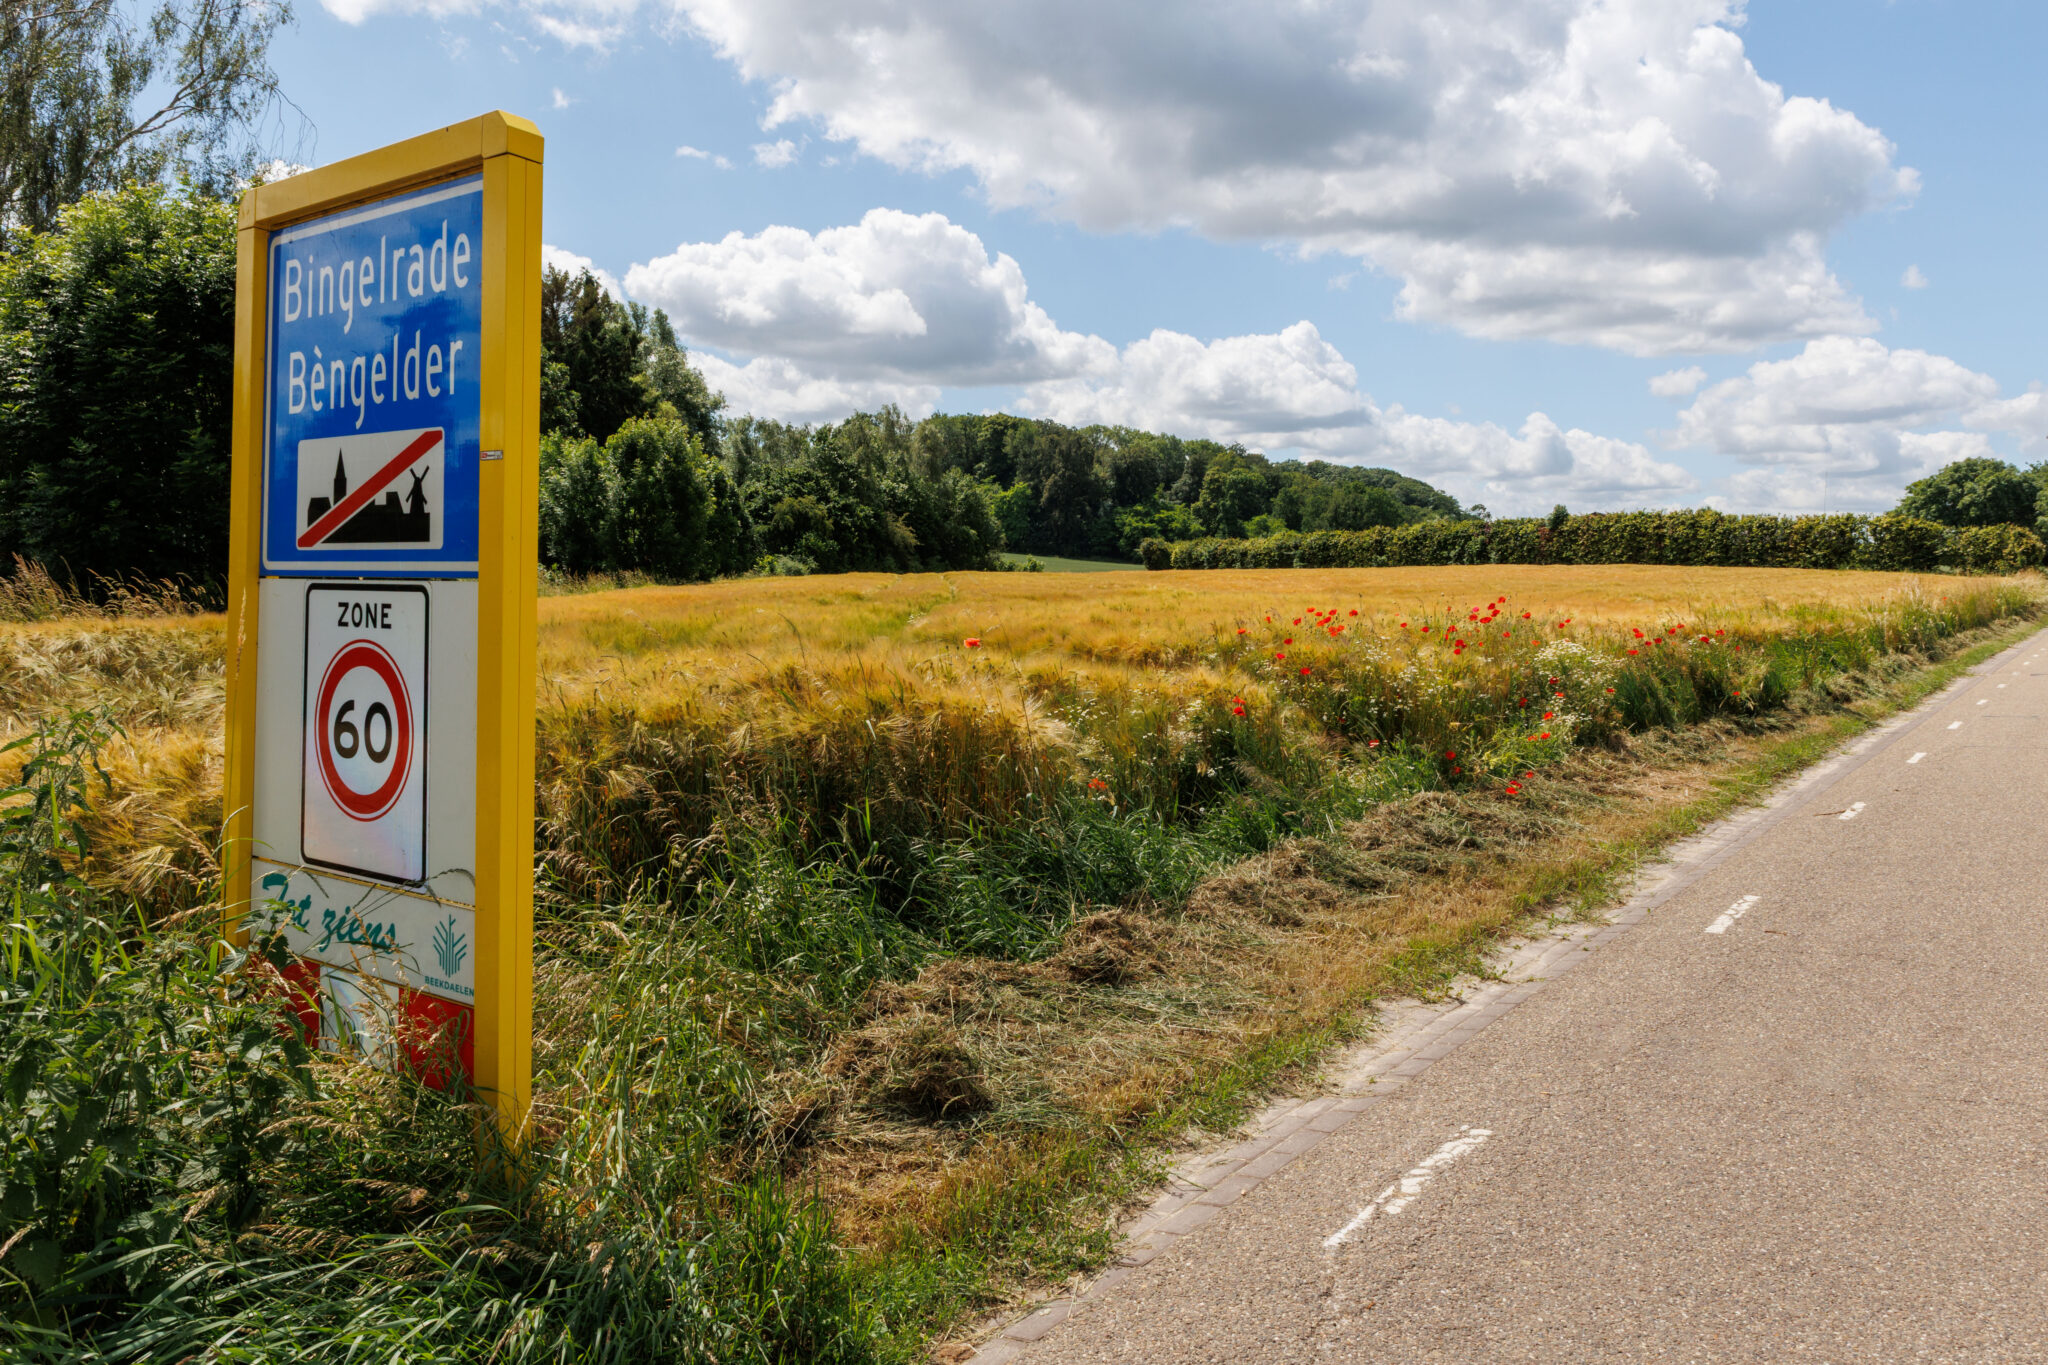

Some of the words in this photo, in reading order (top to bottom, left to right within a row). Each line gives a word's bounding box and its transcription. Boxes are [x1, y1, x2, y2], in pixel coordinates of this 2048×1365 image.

[284, 219, 471, 336] Bingelrade
[288, 329, 463, 430] Bèngelder
[337, 602, 392, 629] ZONE
[333, 699, 393, 764] 60
[319, 905, 400, 955] ziens
[424, 975, 475, 997] BEEKDAELEN
